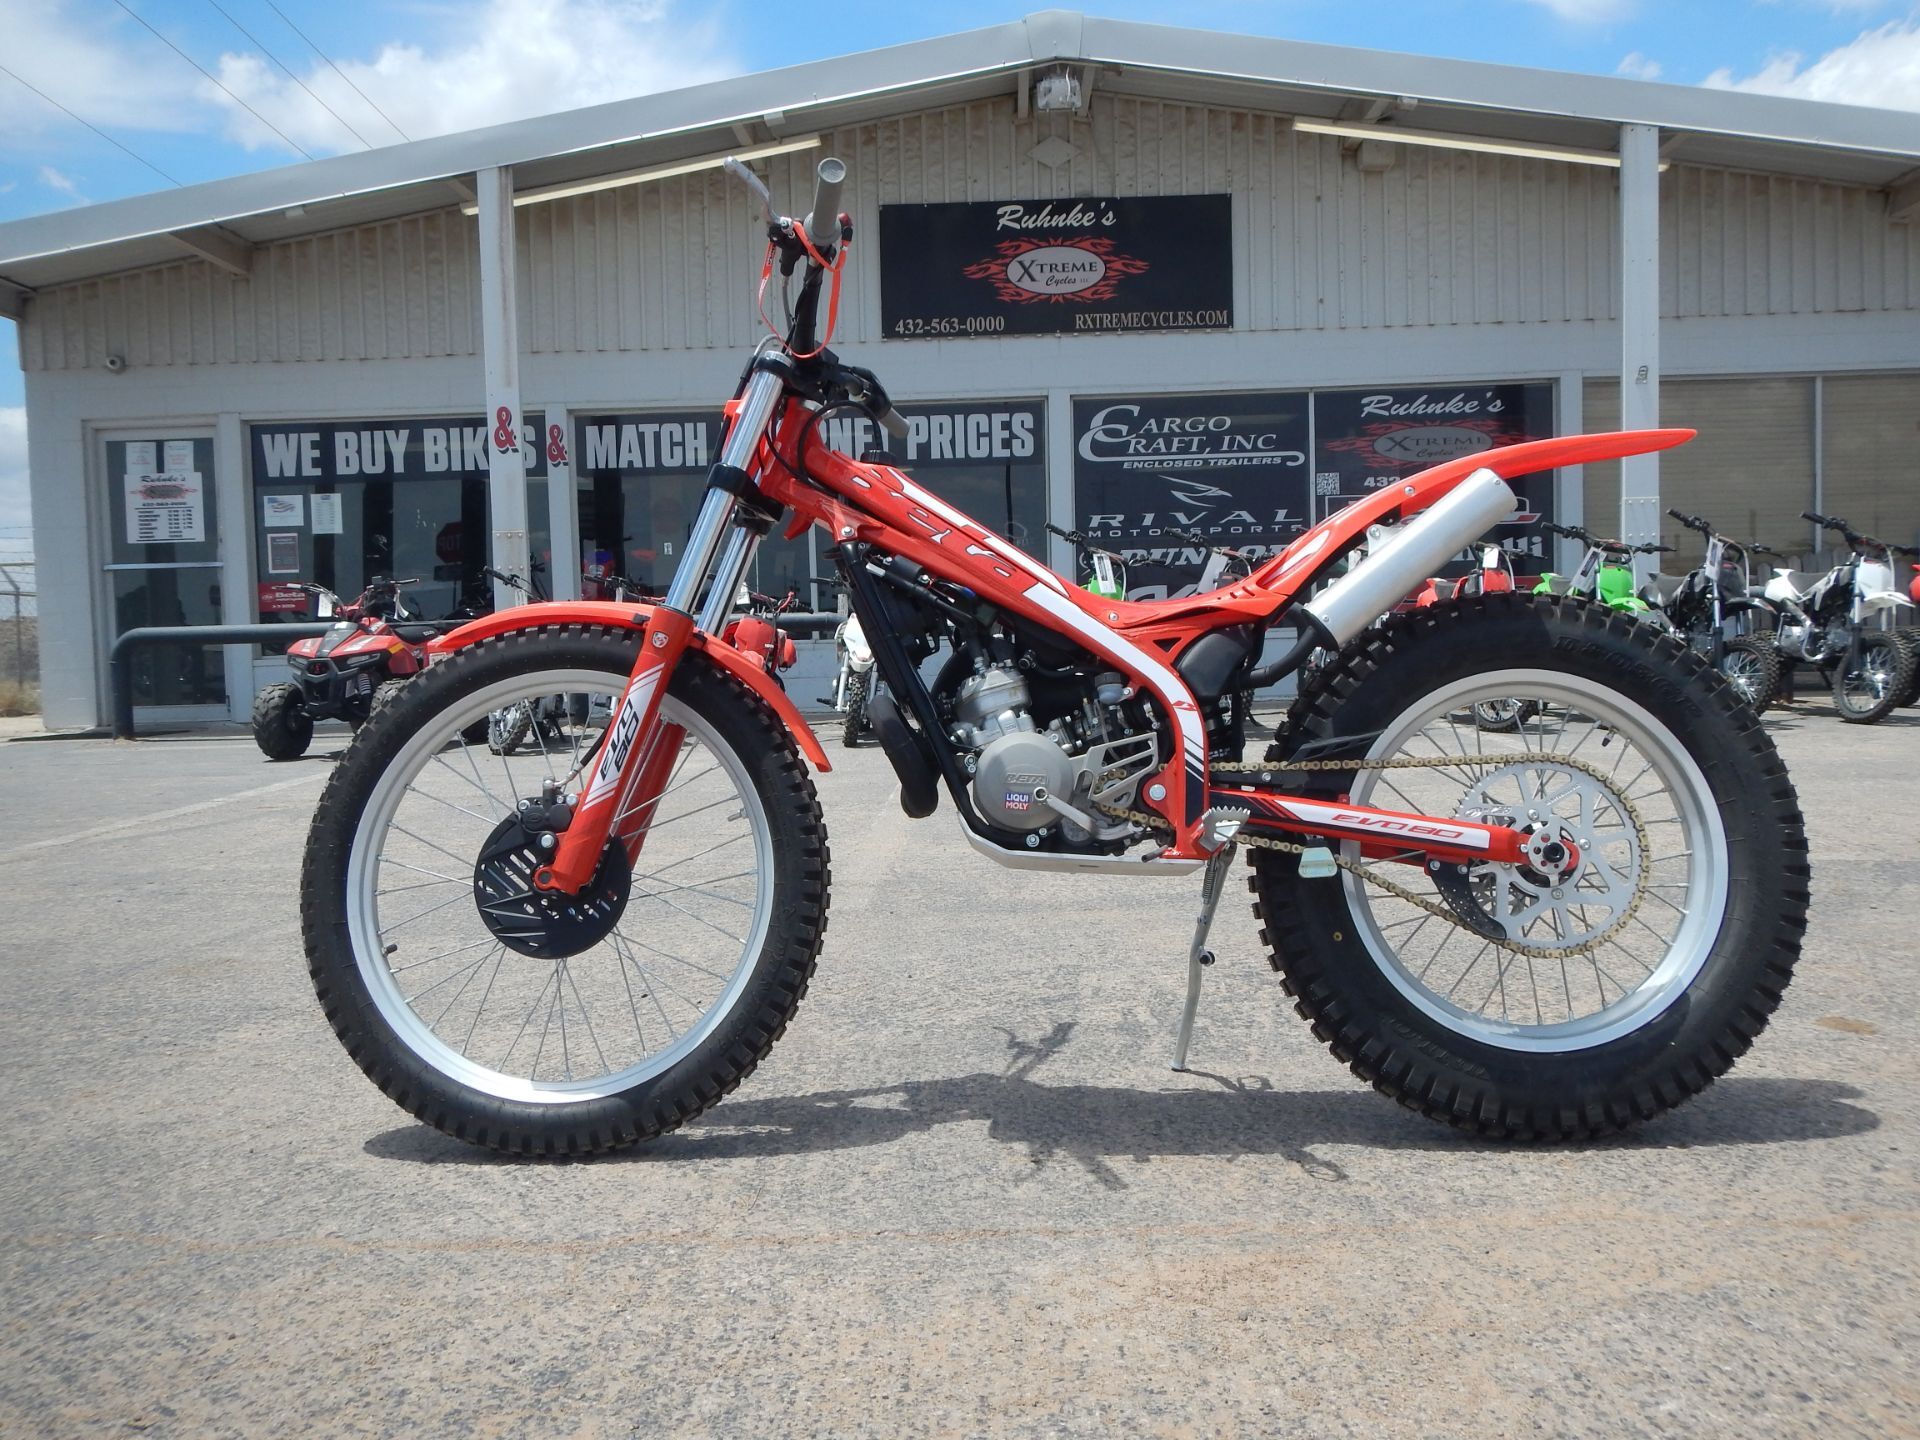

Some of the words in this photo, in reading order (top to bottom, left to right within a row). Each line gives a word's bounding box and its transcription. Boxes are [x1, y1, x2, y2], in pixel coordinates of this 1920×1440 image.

[996, 202, 1117, 231] Ruhnke's
[1015, 260, 1098, 282] XTREME
[1045, 275, 1077, 287] Cycles
[895, 316, 1006, 334] 432-563-0000
[1075, 310, 1229, 329] RXTREMECYCLES.COM
[1360, 391, 1506, 418] Ruhnke's
[493, 406, 520, 454] &
[1090, 404, 1232, 442] CARGO
[261, 431, 322, 478] WE
[334, 429, 410, 475] BUY
[423, 424, 537, 473] BIKS
[547, 423, 569, 468] &
[584, 421, 709, 470] MATCH
[907, 411, 1035, 460] PRICES
[1219, 434, 1277, 451] INC
[1383, 436, 1487, 452] XTREME
[1123, 459, 1204, 469] ENCLOSED
[1208, 456, 1282, 467] TRAILERS
[1088, 509, 1303, 528] RIVAL
[1120, 545, 1290, 566] DUNO
[1005, 801, 1028, 810] MOLY
[1006, 793, 1029, 802] LIQUI
